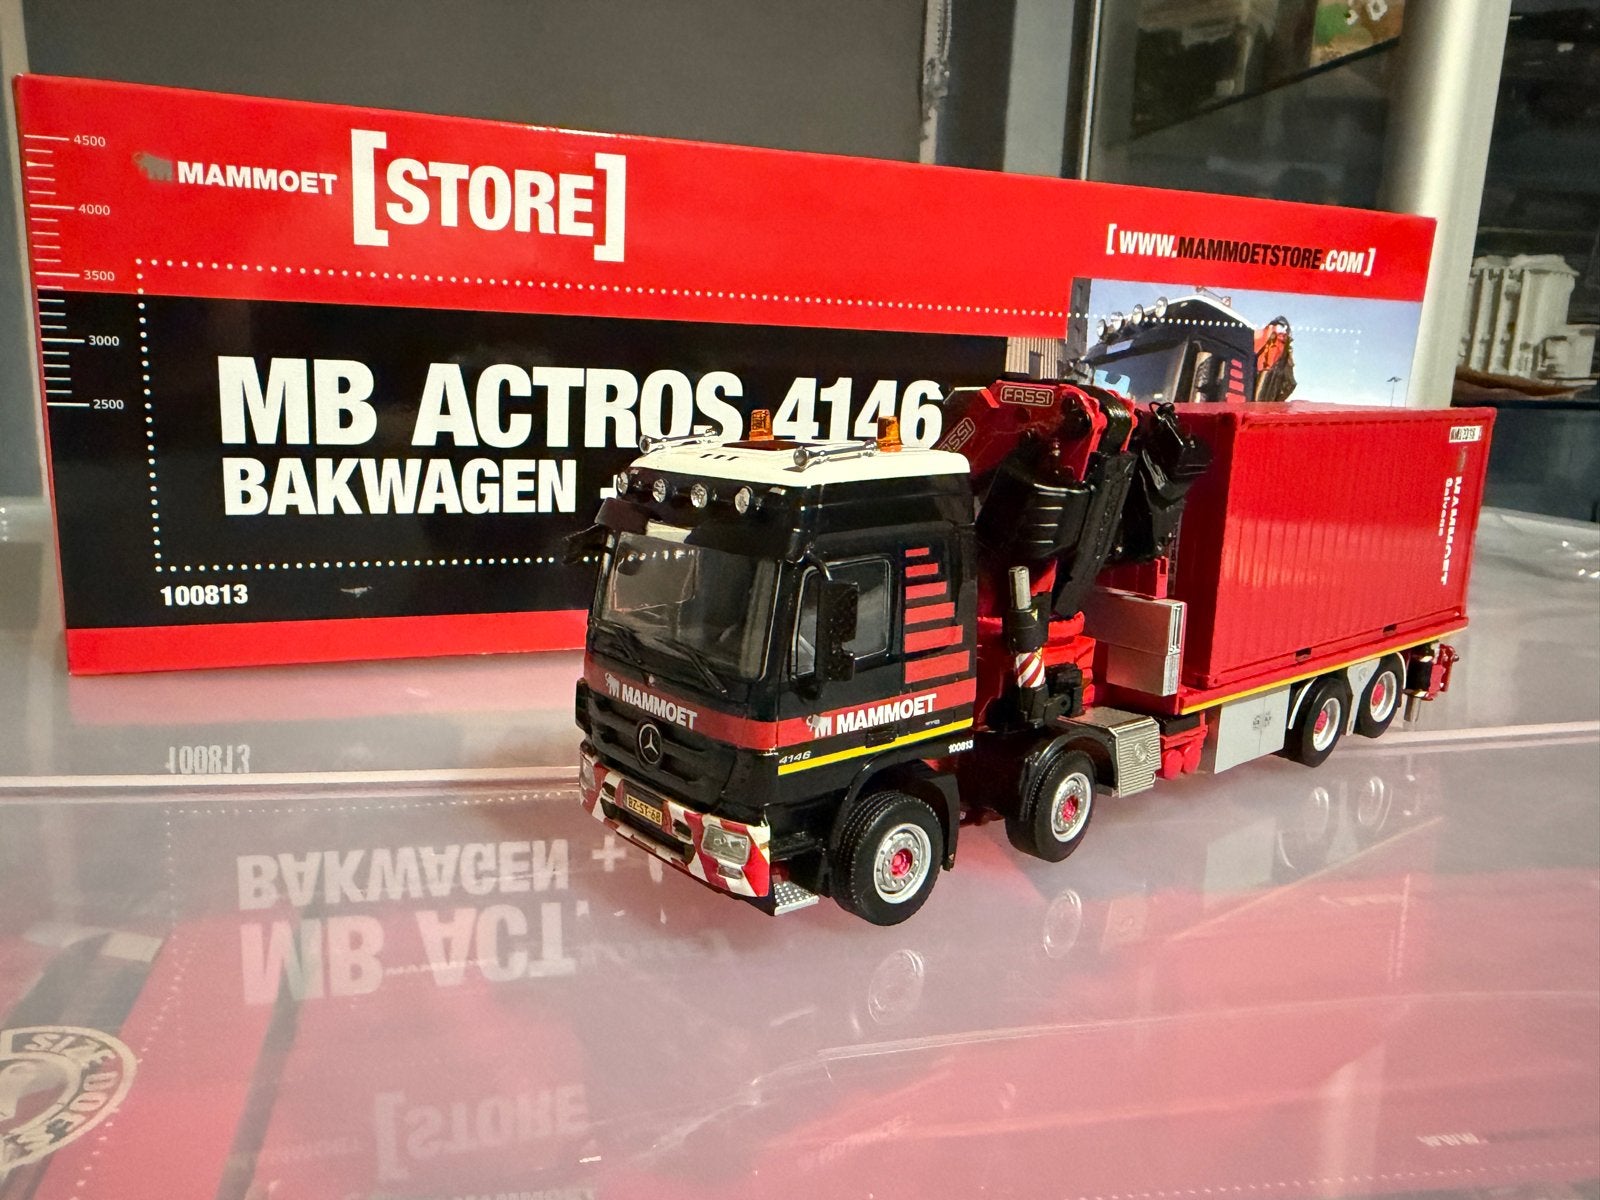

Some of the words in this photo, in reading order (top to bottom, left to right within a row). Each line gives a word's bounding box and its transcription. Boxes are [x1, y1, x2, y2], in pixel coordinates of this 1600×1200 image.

[73, 134, 106, 147] 4500
[177, 160, 338, 196] MAMMOET
[78, 203, 111, 216] 4000
[83, 269, 115, 282] 3500
[88, 334, 120, 347] 3000
[93, 398, 125, 410] 2500
[217, 355, 378, 446] MB
[412, 362, 744, 449] ACTROS
[772, 376, 944, 450] 4146
[1003, 386, 1051, 405] FASSI
[222, 457, 577, 516] BAKWAGEN
[160, 583, 249, 606] 100813
[621, 683, 698, 730] MAMMOET
[836, 692, 938, 734] MAMMOET
[778, 750, 812, 764] 4146
